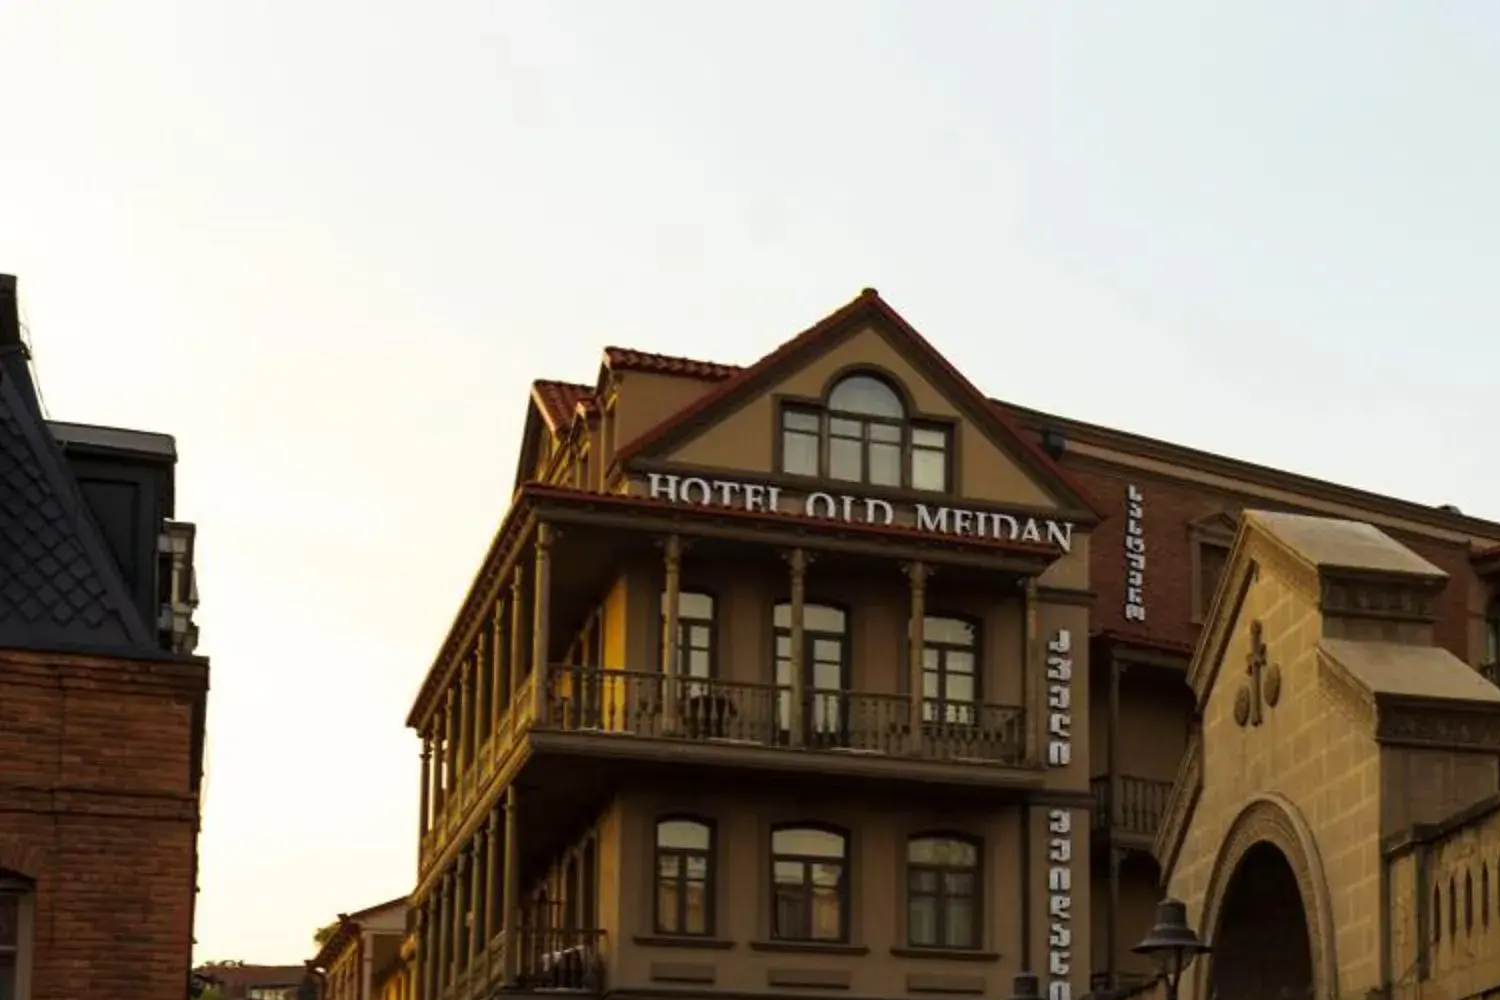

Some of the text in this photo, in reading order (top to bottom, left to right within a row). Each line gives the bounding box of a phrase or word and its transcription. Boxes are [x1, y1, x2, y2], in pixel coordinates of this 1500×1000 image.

[647, 473, 1074, 553] HOTEL OLD MEIDAN
